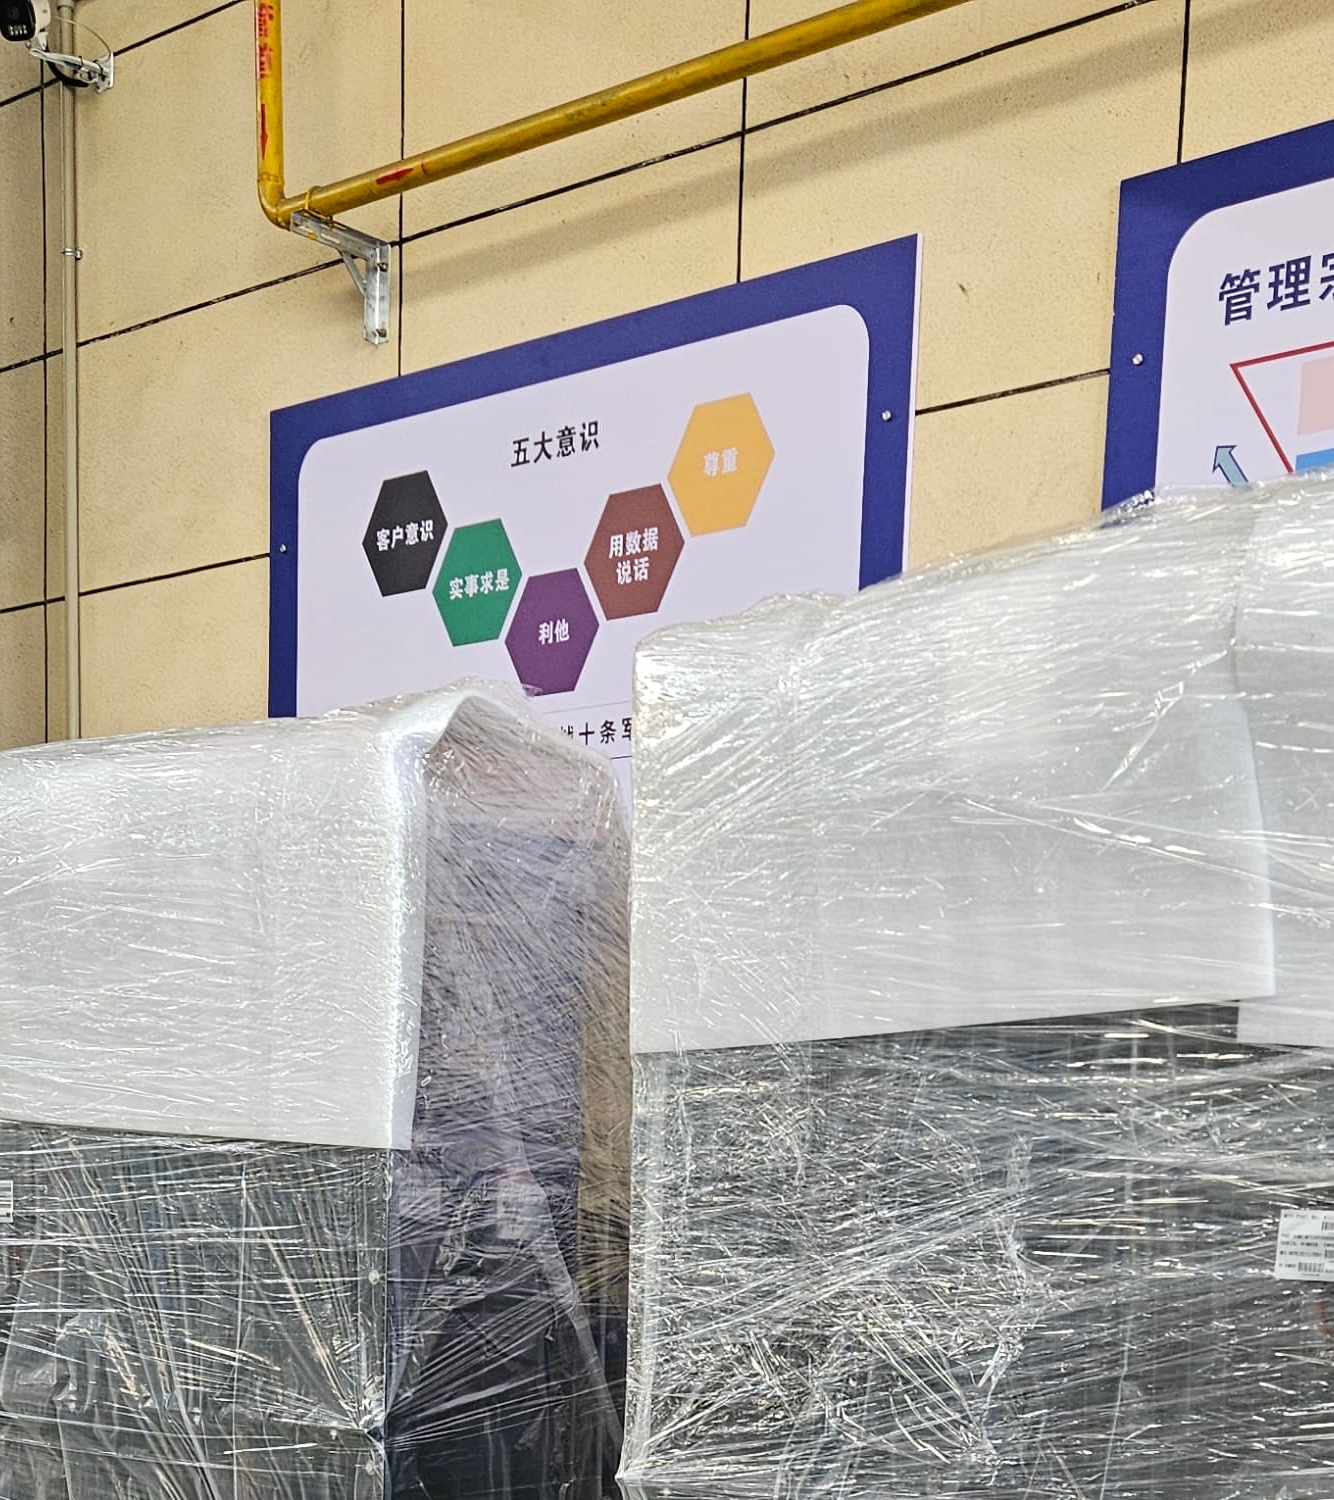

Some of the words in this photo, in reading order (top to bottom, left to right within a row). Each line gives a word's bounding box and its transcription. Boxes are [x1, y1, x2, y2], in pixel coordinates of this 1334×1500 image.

[511, 421, 599, 467] 五大意识
[377, 520, 434, 551] 客户意识
[609, 527, 658, 559] 用数据
[449, 568, 509, 600] 实事求是
[616, 557, 649, 584] 说话
[539, 619, 569, 645] 利他
